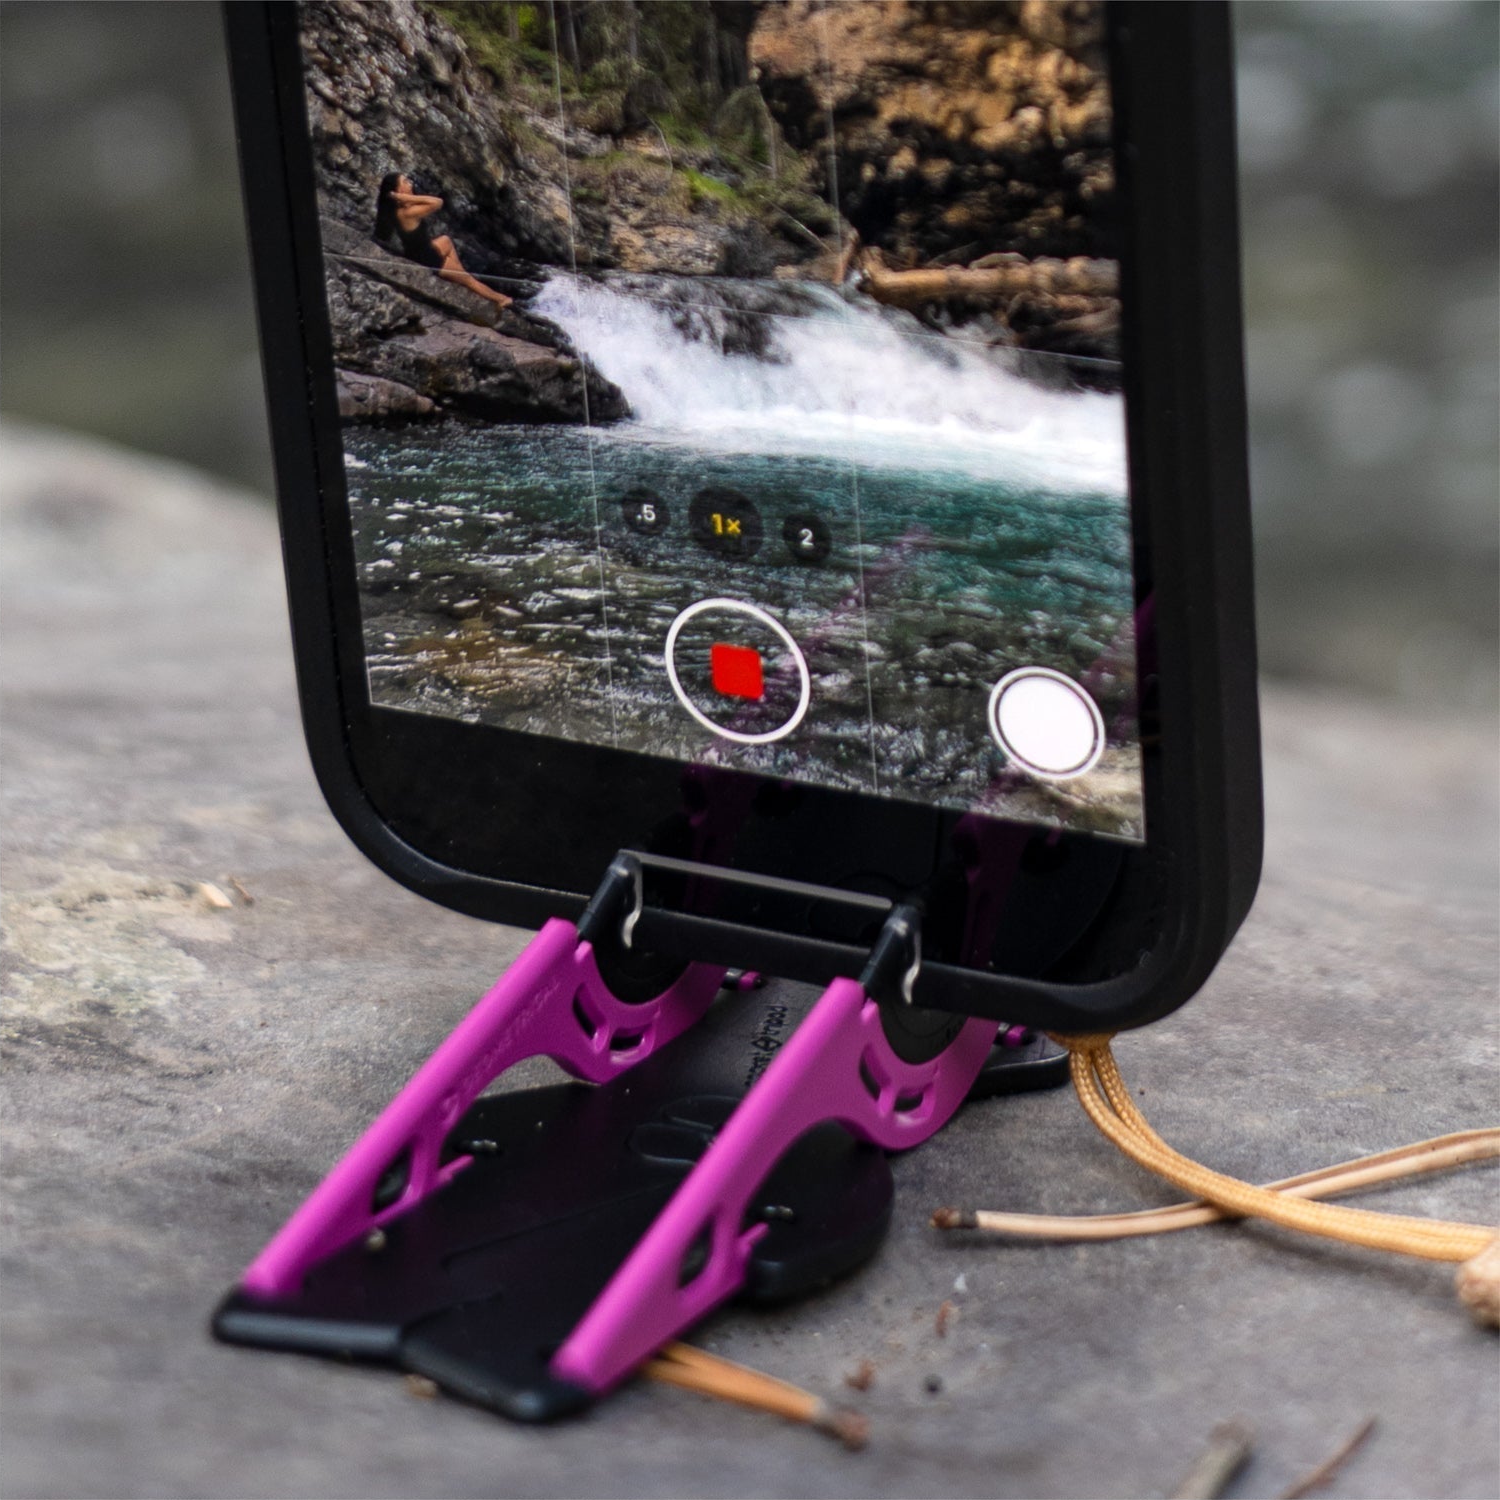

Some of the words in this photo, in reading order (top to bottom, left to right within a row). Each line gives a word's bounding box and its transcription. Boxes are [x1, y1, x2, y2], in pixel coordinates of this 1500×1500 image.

[636, 504, 656, 521] .5
[711, 513, 741, 536] 1x
[800, 528, 815, 547] 2
